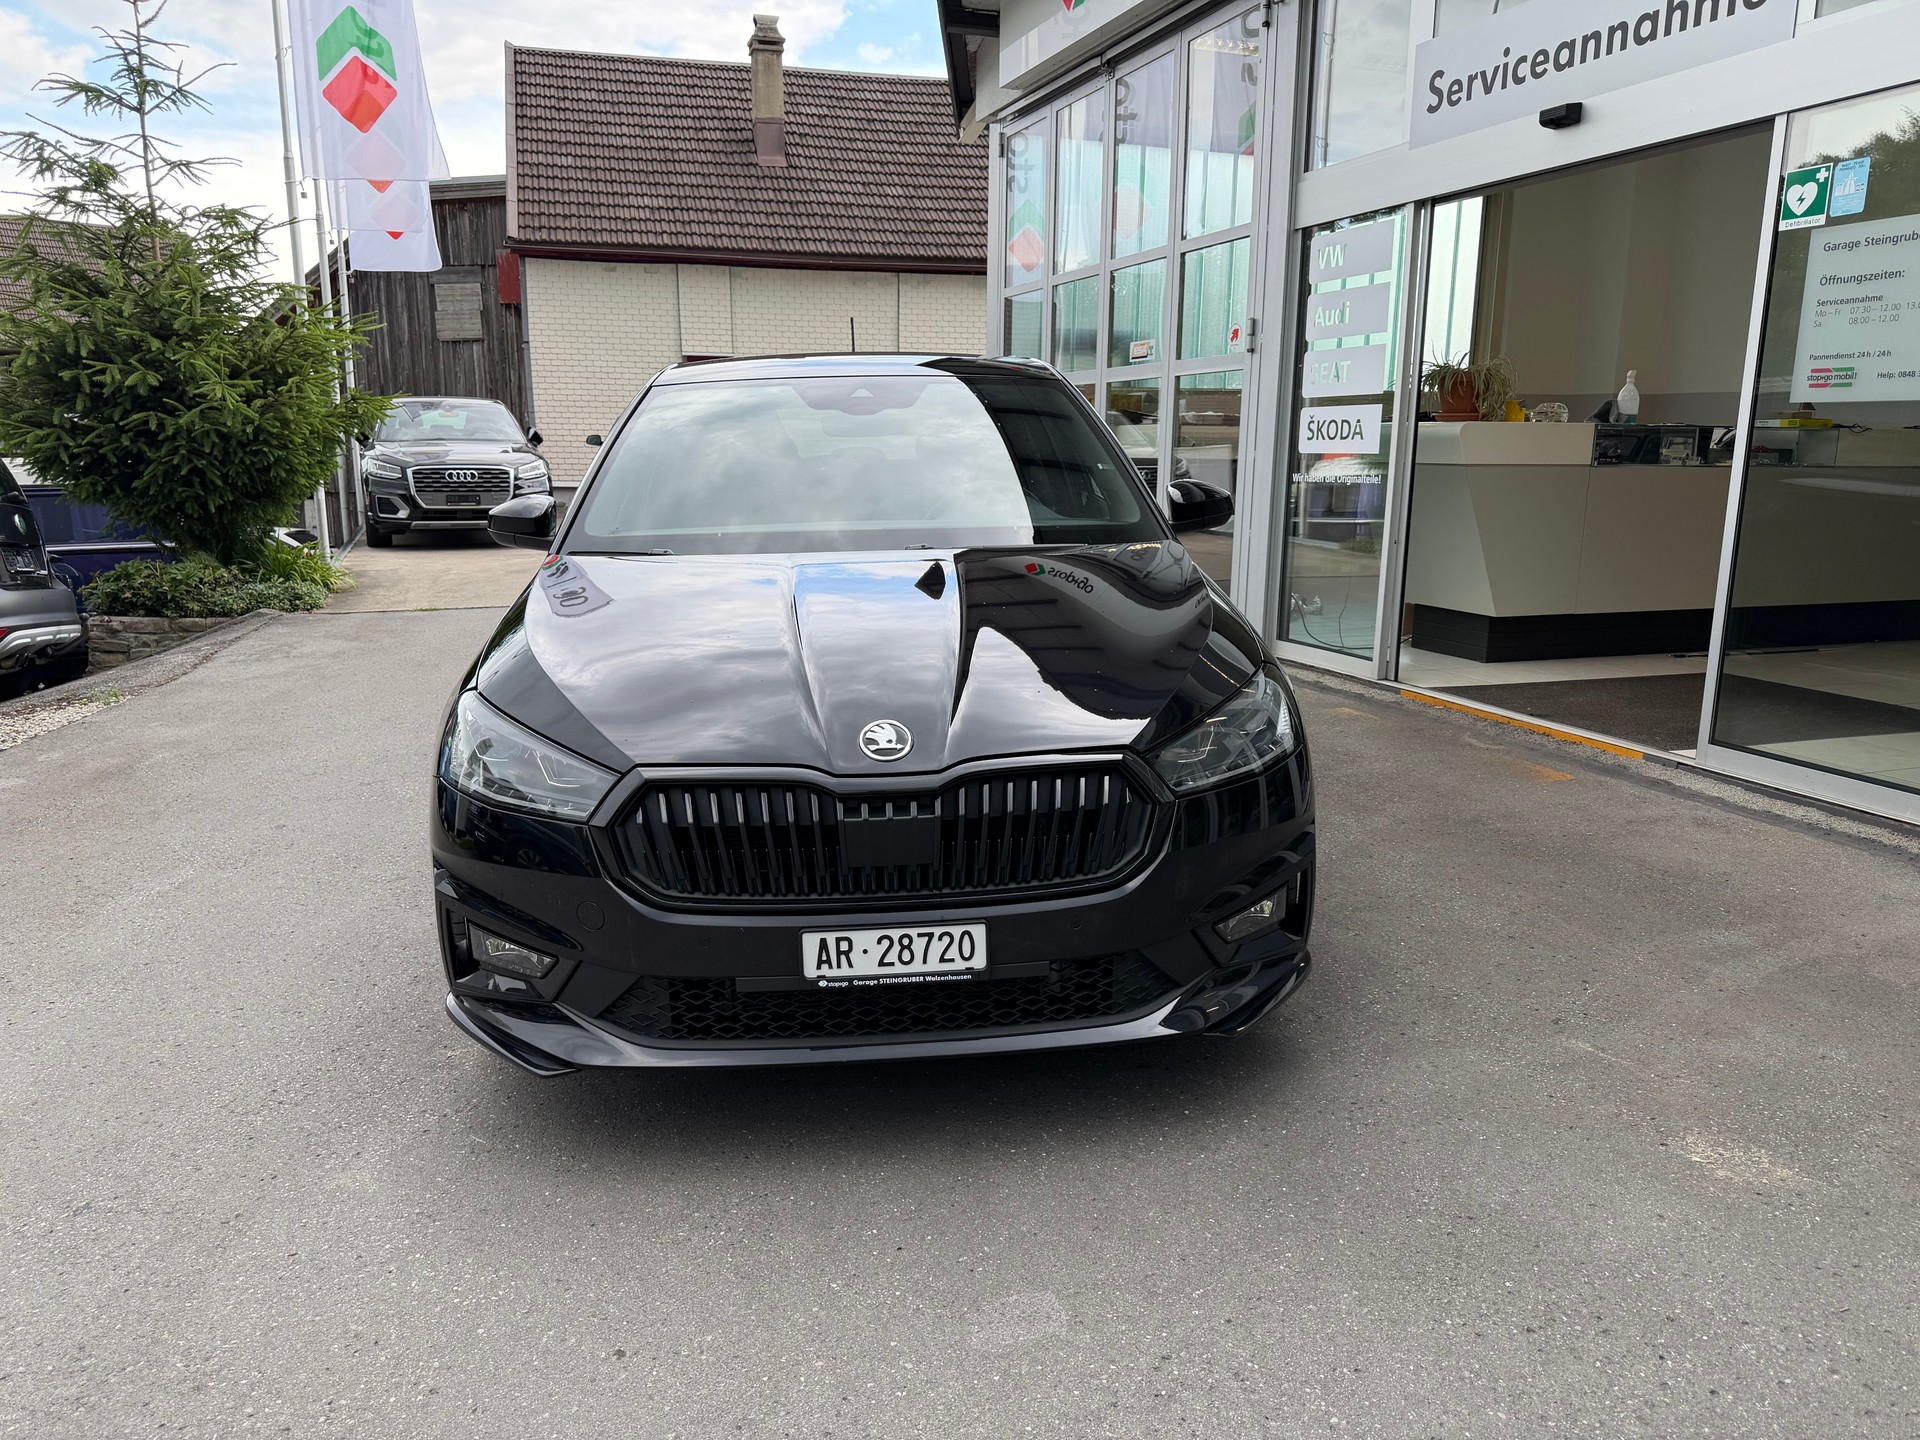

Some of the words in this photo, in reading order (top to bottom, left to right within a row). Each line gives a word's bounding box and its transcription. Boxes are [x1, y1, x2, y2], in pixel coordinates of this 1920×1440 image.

[1426, 0, 1767, 114] Serviceannahm
[1823, 240, 1861, 252] Garage
[1864, 230, 1920, 247] Steingrub
[1318, 243, 1347, 270] VW
[1819, 269, 1905, 286] Öffnungszeiten:
[1816, 294, 1884, 307] Serviceannahme
[1313, 301, 1350, 328] Audi
[1813, 320, 1822, 328] Sa
[1809, 352, 1856, 361] Pannendienst
[1877, 371, 1896, 380] Help:
[1897, 370, 1916, 378] 0848
[1307, 414, 1364, 441] ŠKODA
[1292, 473, 1303, 482] Wir
[1304, 473, 1324, 483] haben
[1325, 474, 1336, 483] die
[1337, 474, 1382, 485] Originalteile!
[853, 978, 878, 987] Garage
[879, 976, 924, 985] STEINGRUBER
